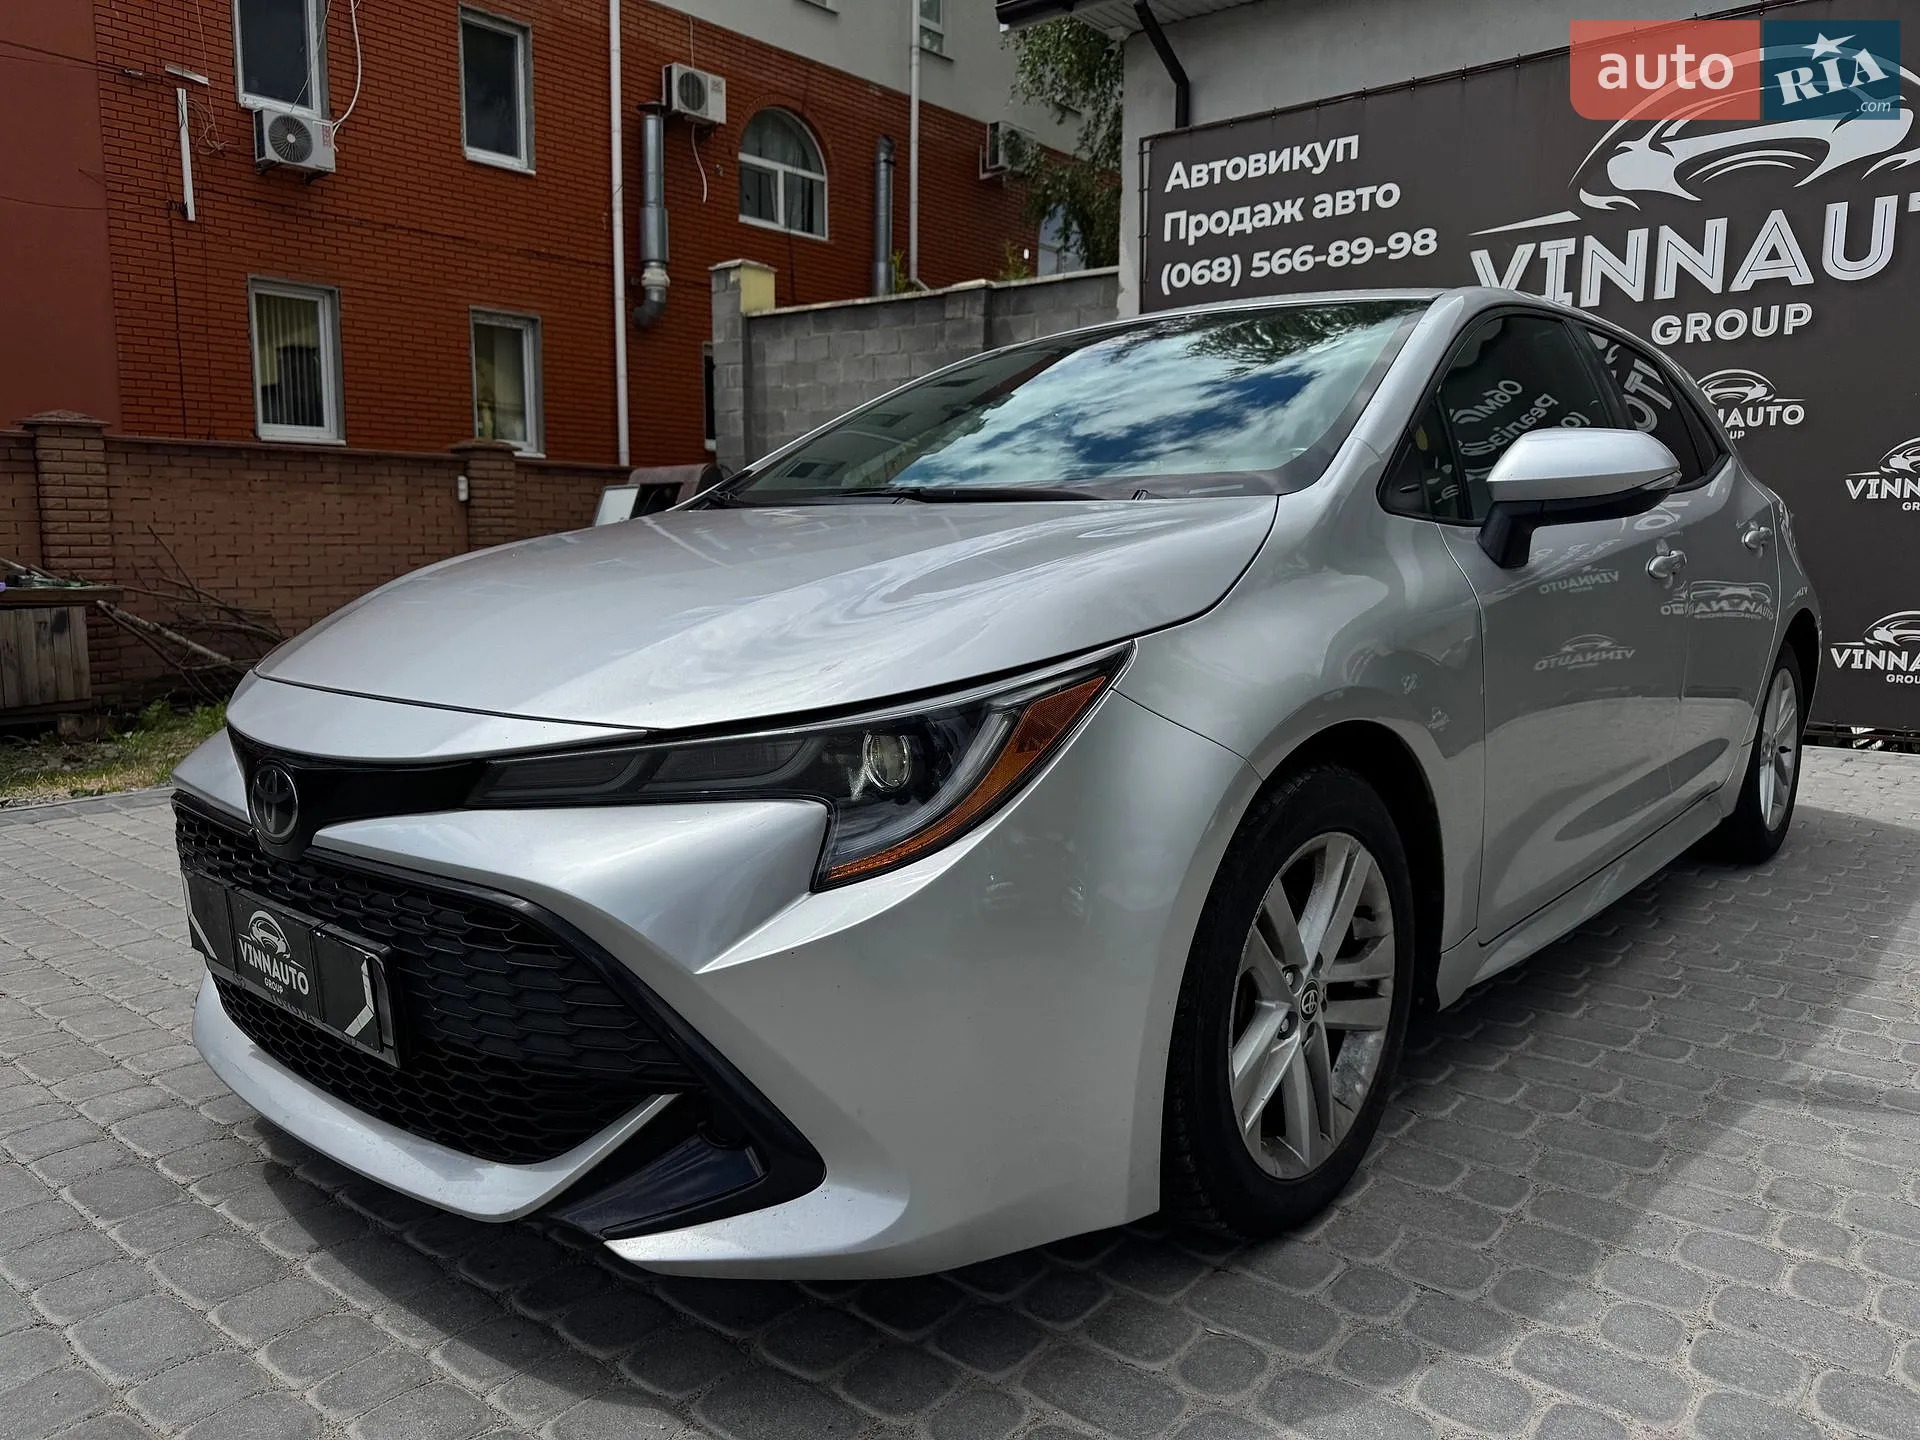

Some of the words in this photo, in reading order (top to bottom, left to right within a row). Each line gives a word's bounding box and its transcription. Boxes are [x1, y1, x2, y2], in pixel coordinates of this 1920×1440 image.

[1164, 134, 1360, 193] Автовикуп
[1163, 197, 1305, 246] Продаж
[1312, 182, 1401, 219] авто
[1160, 253, 1242, 296] (068)
[1250, 227, 1438, 279] 566-89-98
[1470, 191, 1920, 308] VINNAU
[1651, 301, 1813, 346] GROUP
[238, 938, 309, 995] VINNAUTO
[264, 976, 284, 994] GROUP
